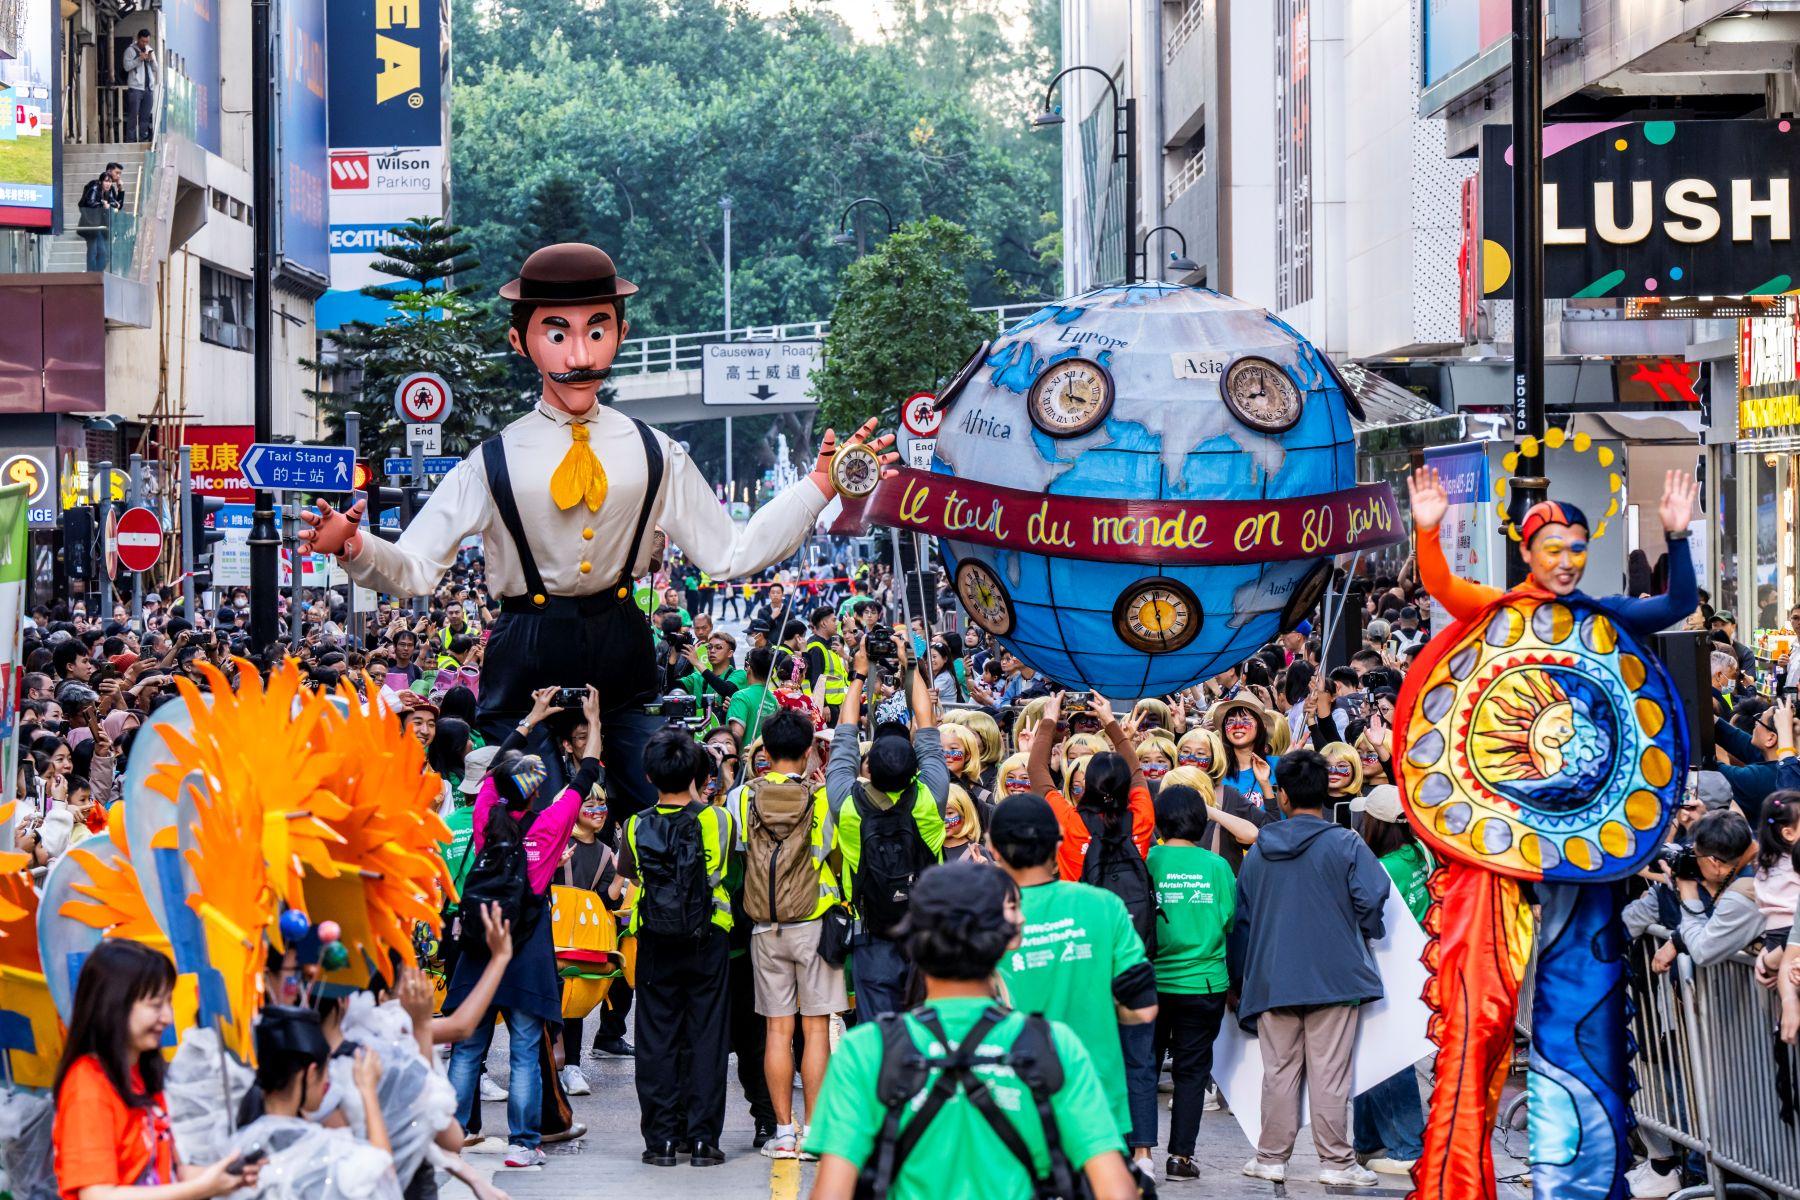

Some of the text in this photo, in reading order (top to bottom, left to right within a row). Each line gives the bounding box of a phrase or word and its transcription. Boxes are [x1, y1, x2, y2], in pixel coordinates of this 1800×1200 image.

[376, 158, 430, 170] Wilson
[377, 176, 430, 190] Parking
[1543, 178, 1790, 244] LUSH
[329, 230, 413, 248] ECATHL
[1058, 326, 1128, 349] Europe
[710, 345, 813, 358] Causeway Road
[726, 365, 800, 380] 高士威道
[1184, 359, 1224, 374] Asia
[1516, 374, 1526, 430] 50240
[960, 409, 1011, 439] Africa
[426, 440, 436, 449] 止
[190, 443, 239, 472] 惠康
[268, 450, 332, 463] Taxi Stand
[190, 475, 250, 490] ellcome
[273, 467, 324, 484] 的士站
[244, 516, 254, 525] Roa
[1026, 500, 1076, 548] du
[1234, 510, 1284, 552] en
[1301, 504, 1332, 552] 80
[700, 655, 708, 663] G
[1021, 928, 1086, 948] ArtsInThePark
